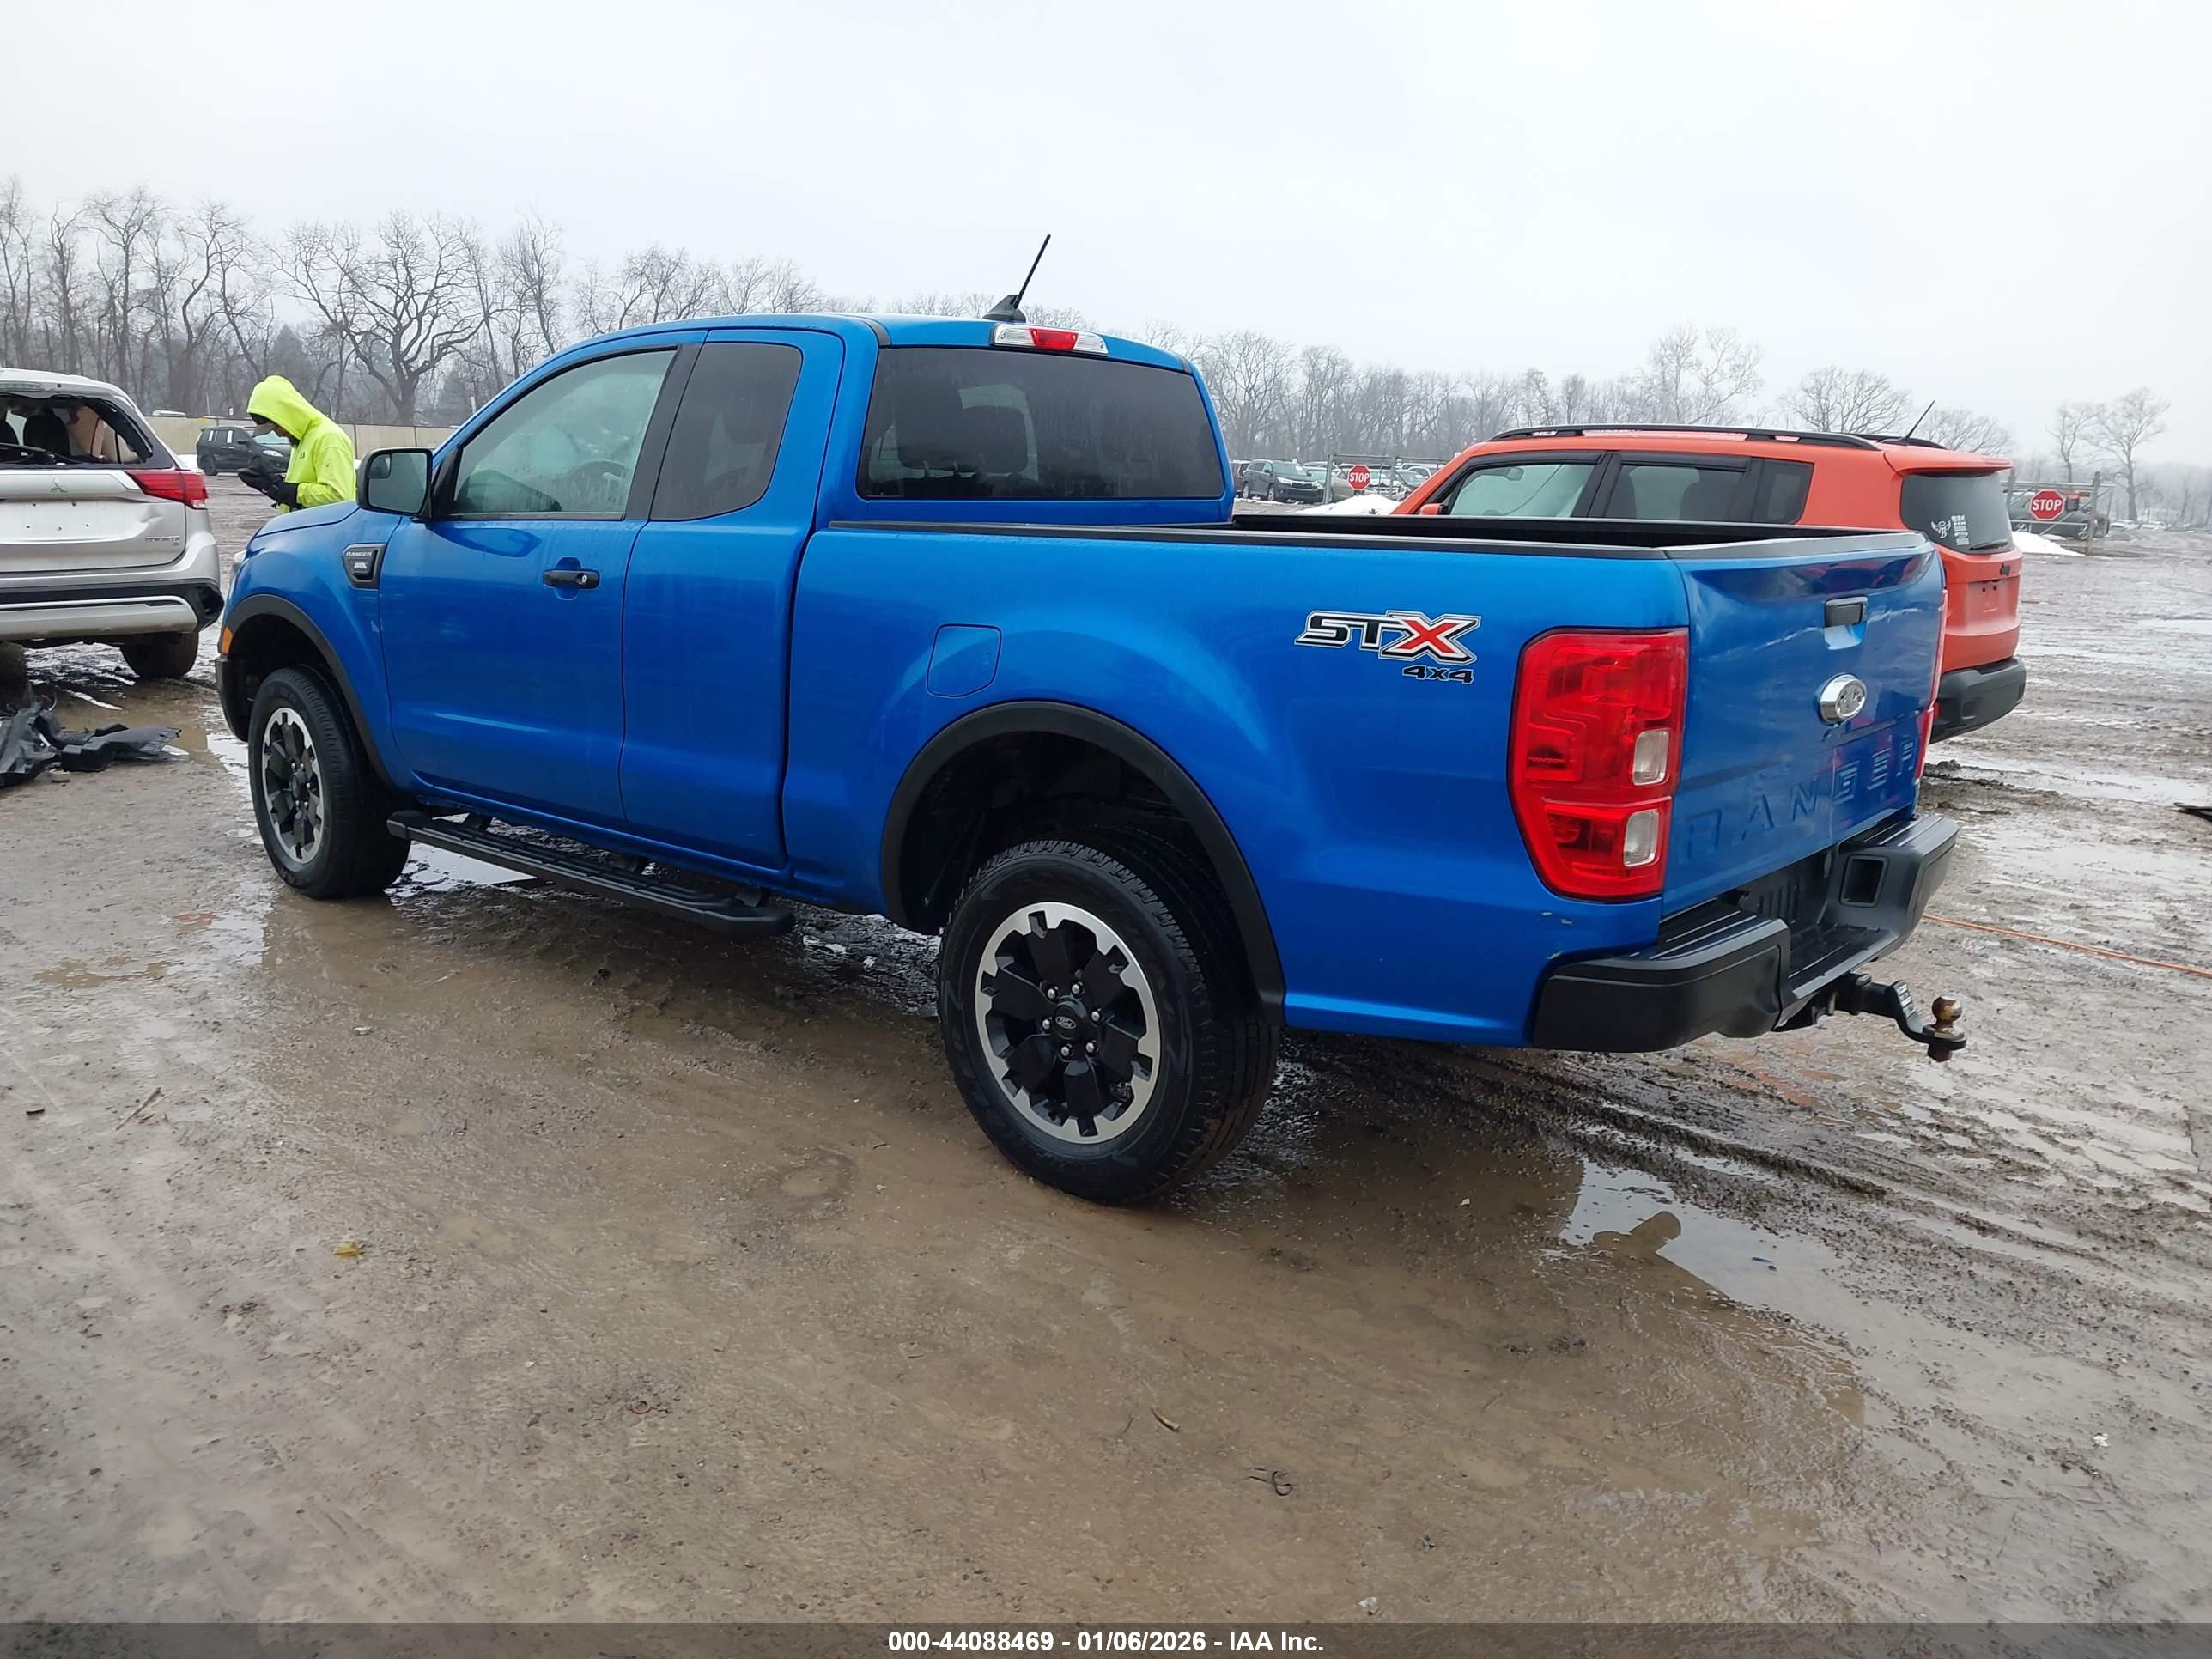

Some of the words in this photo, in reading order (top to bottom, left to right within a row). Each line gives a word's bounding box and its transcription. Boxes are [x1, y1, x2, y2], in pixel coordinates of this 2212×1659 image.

[1350, 472, 1370, 483] STOP
[2032, 499, 2062, 511] STOP
[1294, 610, 1482, 665] STX
[1680, 734, 1916, 864] RANGER
